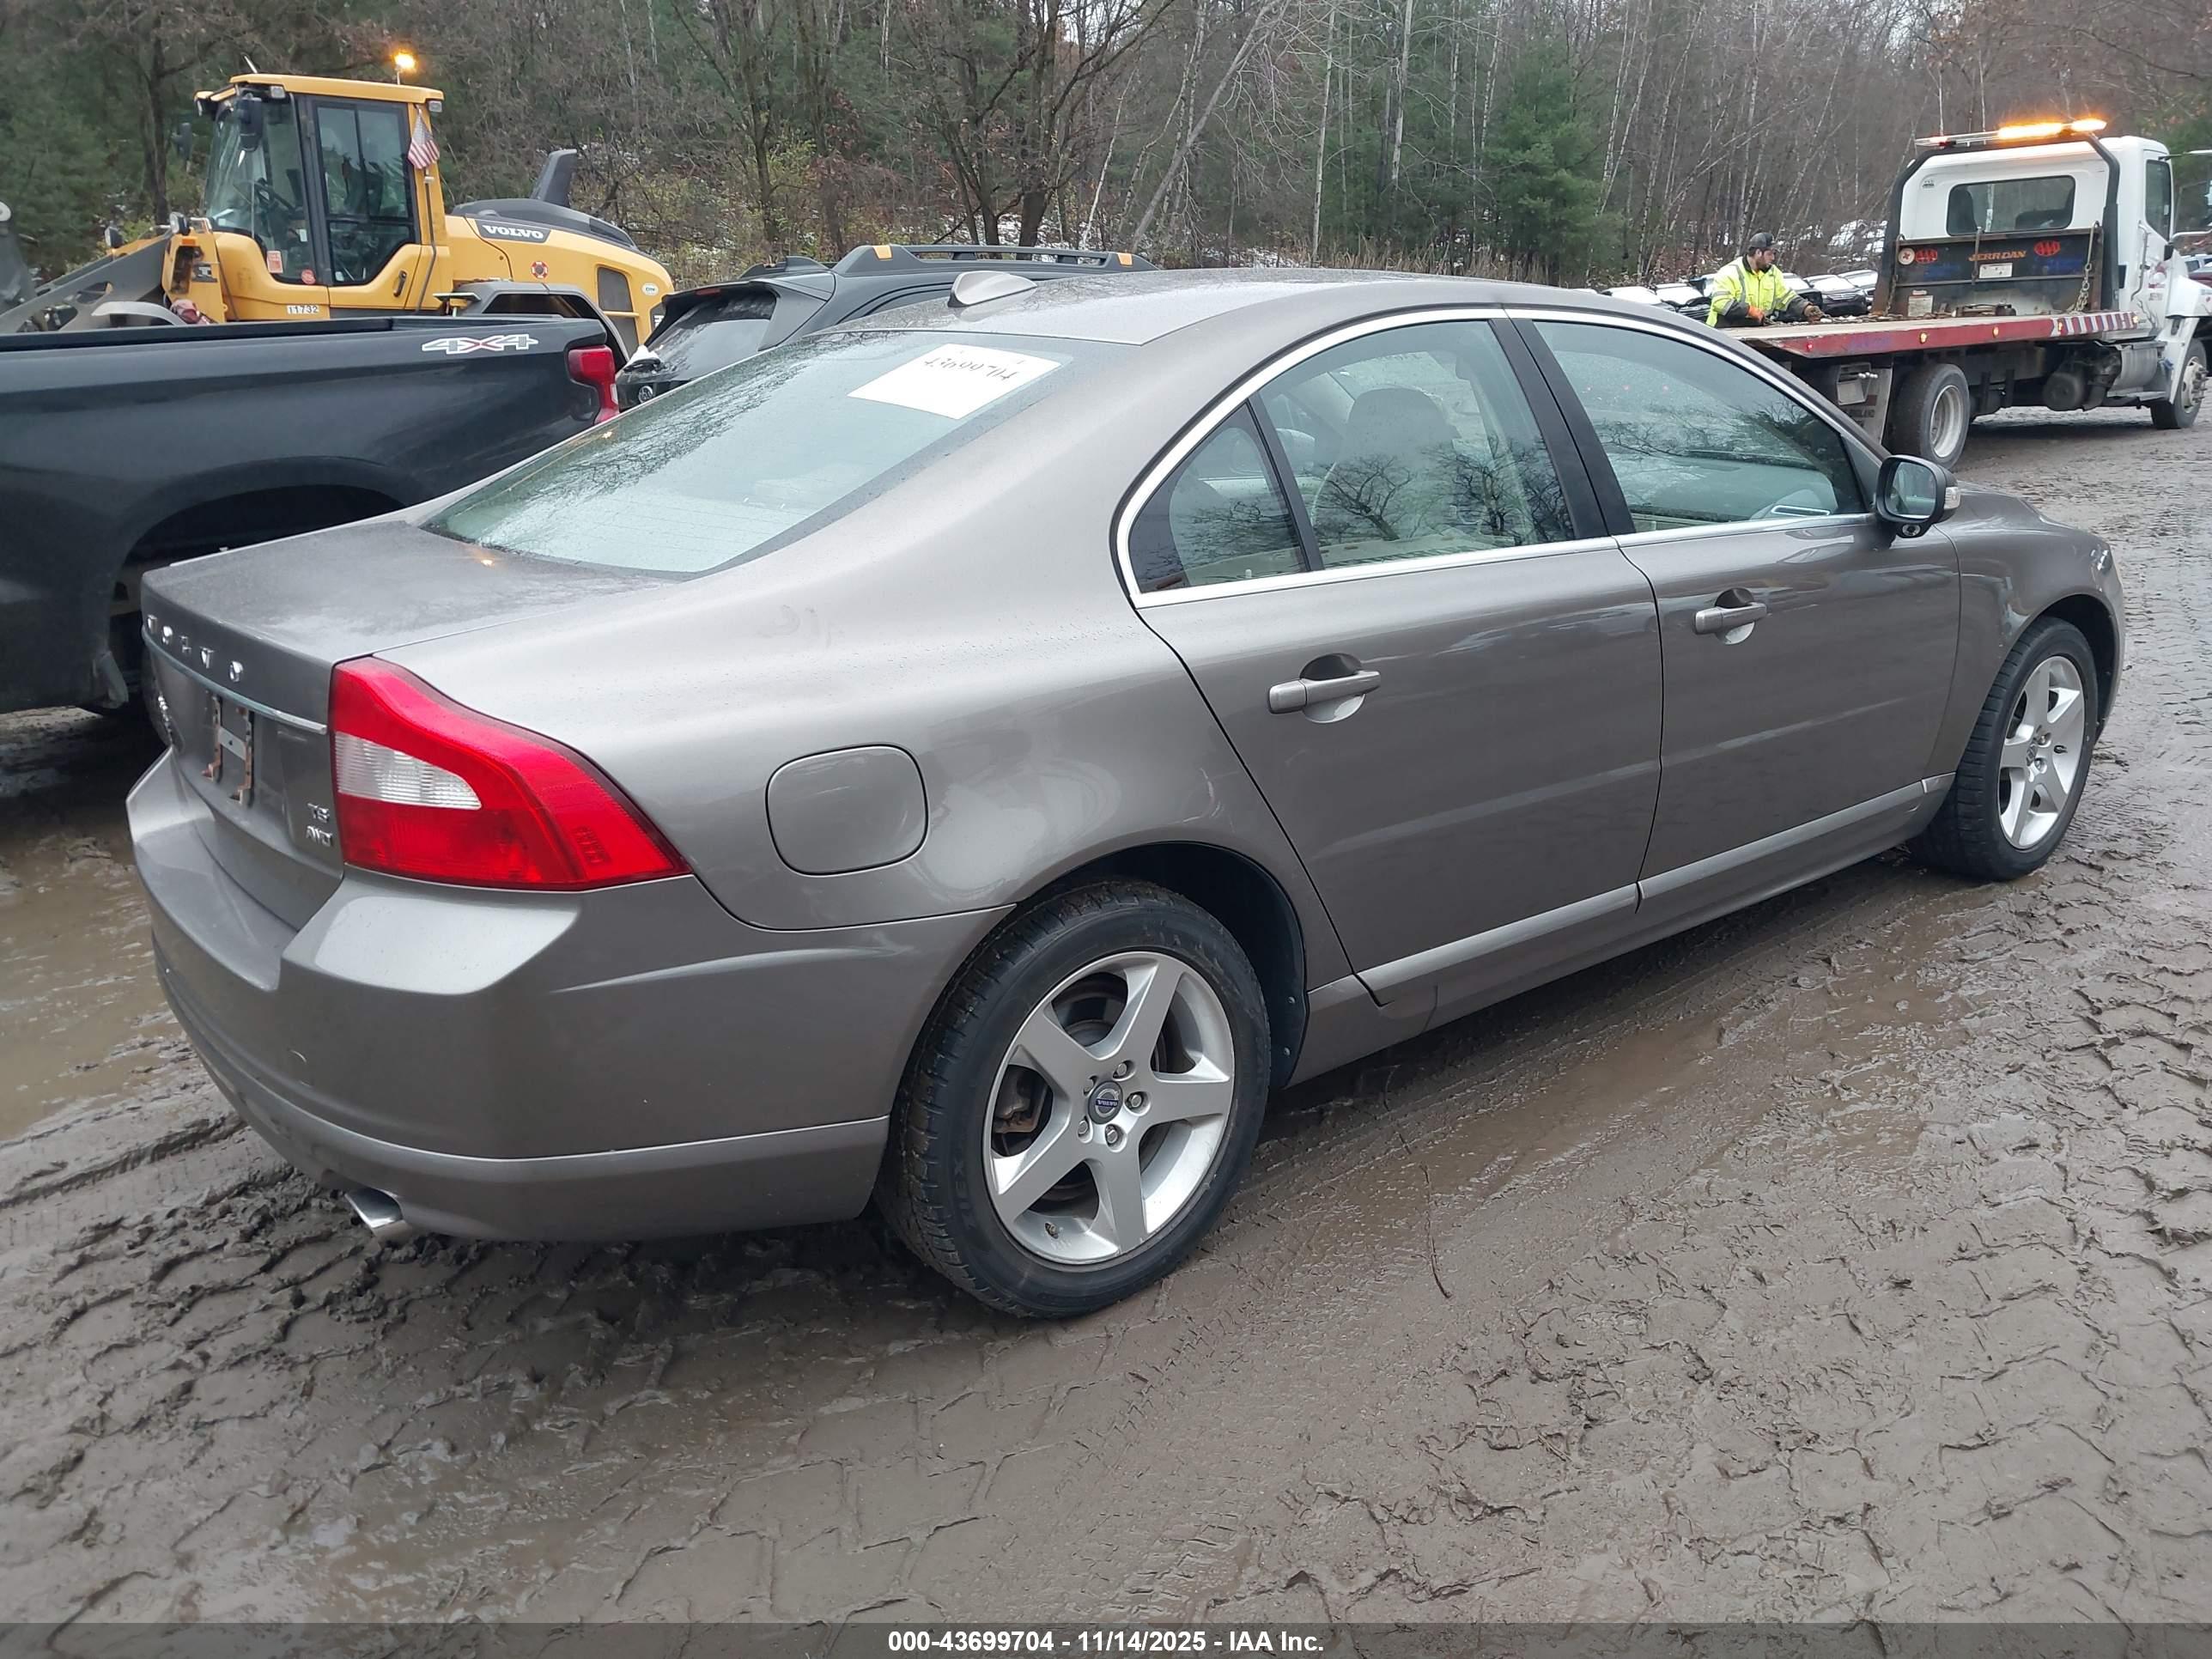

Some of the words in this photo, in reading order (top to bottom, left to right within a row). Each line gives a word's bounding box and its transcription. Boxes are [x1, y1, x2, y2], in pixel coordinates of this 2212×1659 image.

[483, 225, 544, 239] VOLVO
[289, 304, 319, 313] 11732
[147, 614, 244, 683] VOLVO
[306, 825, 332, 848] AWD
